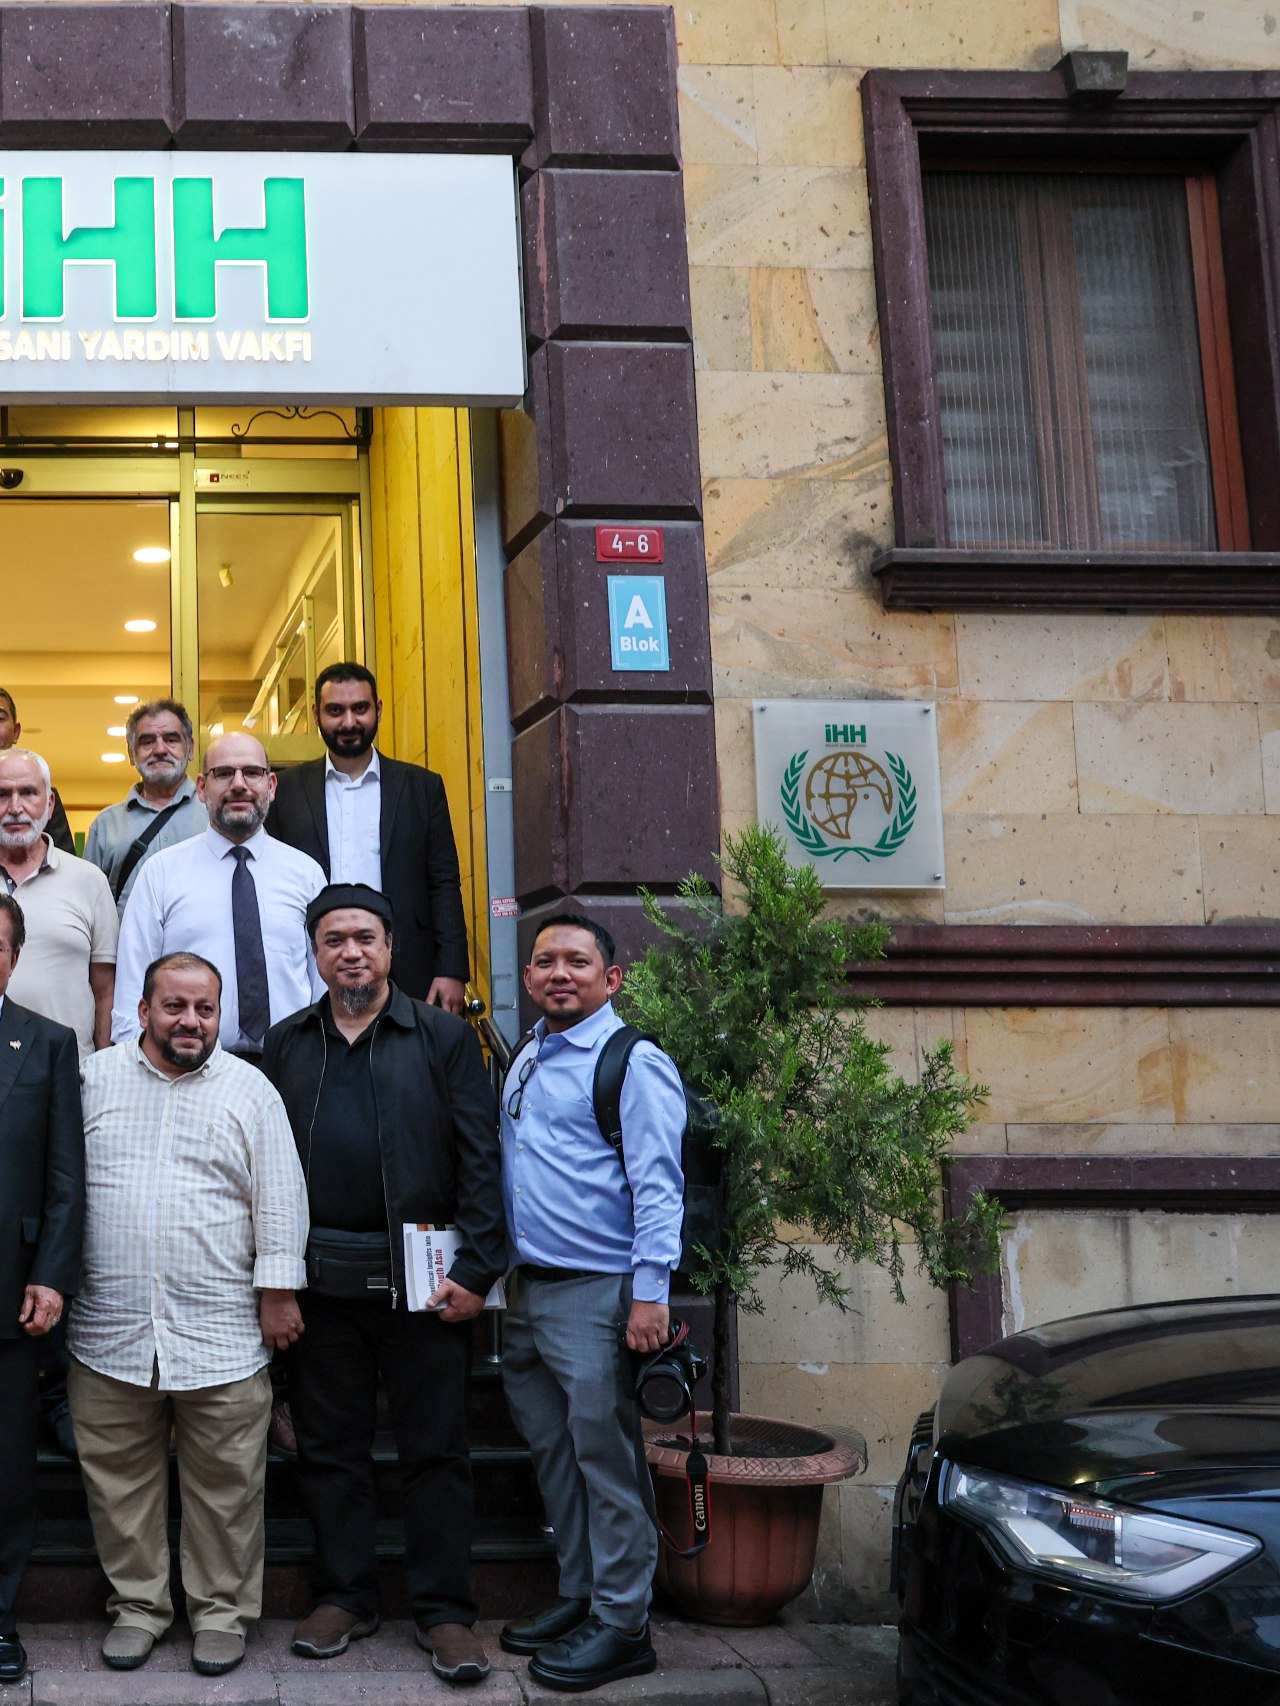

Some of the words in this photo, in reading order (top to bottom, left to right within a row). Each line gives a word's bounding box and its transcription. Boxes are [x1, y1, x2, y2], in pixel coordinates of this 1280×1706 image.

[77, 330, 209, 361] YARDIM
[216, 330, 312, 362] VAKFI
[612, 533, 649, 553] 4-6
[624, 594, 653, 629] A
[620, 635, 660, 653] Blok
[434, 1249, 443, 1266] Asia
[428, 1271, 436, 1295] political
[694, 1484, 706, 1531] Canon
